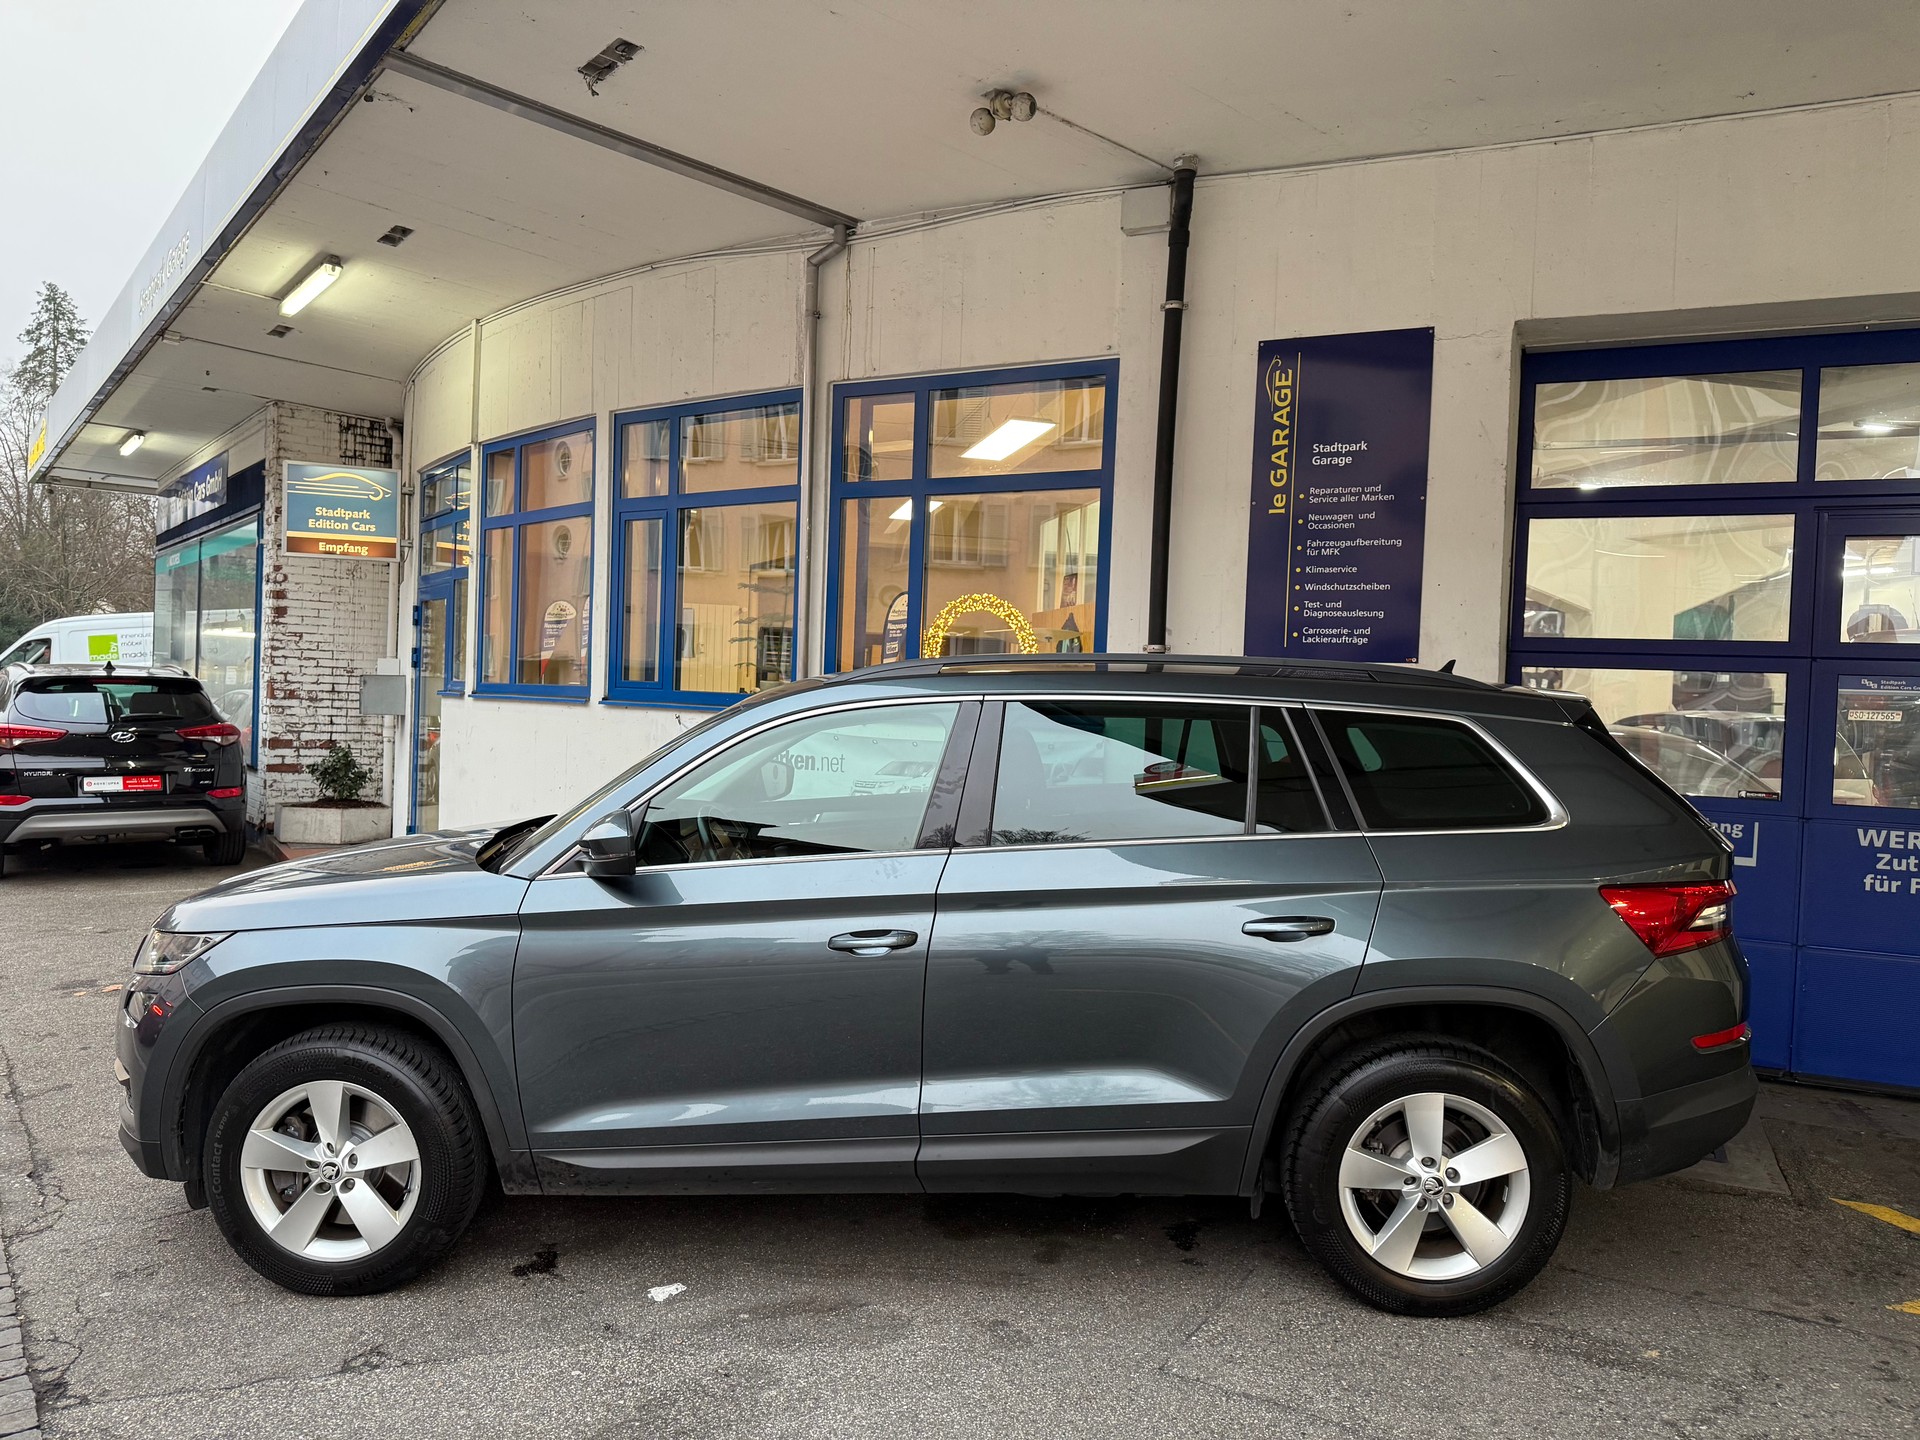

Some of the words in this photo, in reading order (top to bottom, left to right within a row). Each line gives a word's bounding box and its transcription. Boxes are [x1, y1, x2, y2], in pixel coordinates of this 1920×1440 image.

[1269, 368, 1293, 487] GARAGE
[1312, 441, 1368, 453] Stadtpark
[1312, 456, 1353, 466] Garage
[1309, 487, 1362, 496] Reparaturen
[1364, 484, 1382, 493] und
[1309, 495, 1338, 503] Service
[1340, 495, 1359, 503] aller
[1361, 493, 1395, 502] Marken
[1268, 493, 1287, 514] le
[315, 507, 371, 520] Stadtpark
[1308, 513, 1354, 522] Neuwagen
[1358, 511, 1376, 520] und
[308, 519, 349, 530] Edition
[352, 522, 376, 532] Cars
[1307, 522, 1355, 530] Occasionen
[1306, 538, 1403, 548] Fahrzeugaufbereitung
[318, 542, 369, 556] Empfang
[1306, 548, 1320, 556] für
[1321, 548, 1341, 556] MFK
[1305, 565, 1358, 573] Klimaservice
[1304, 583, 1391, 591] Windschutzscheiben
[1304, 600, 1323, 608] Test-
[1325, 600, 1342, 608] und
[1303, 609, 1385, 618] Diagnoseauslesung
[1302, 627, 1352, 635] Carrosserie-
[1353, 627, 1371, 635] und
[1302, 636, 1369, 645] Lackieraufträge
[1863, 873, 1902, 893] für
